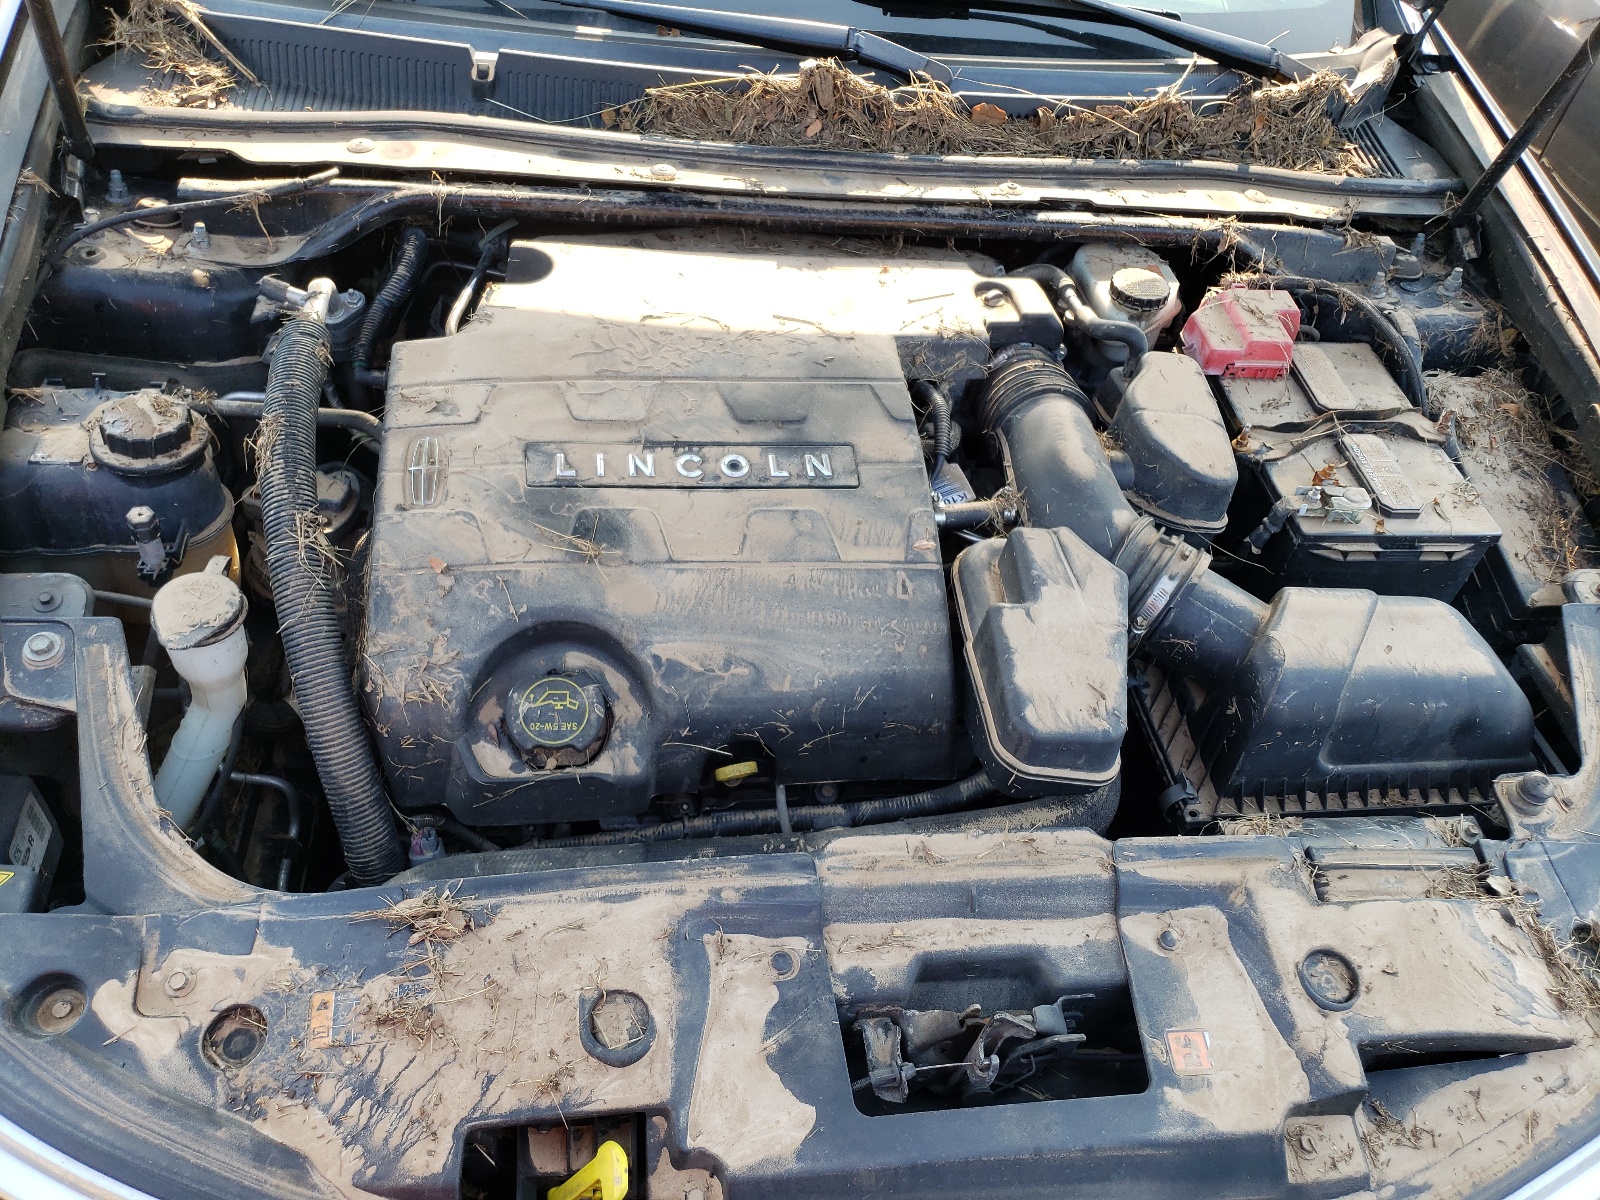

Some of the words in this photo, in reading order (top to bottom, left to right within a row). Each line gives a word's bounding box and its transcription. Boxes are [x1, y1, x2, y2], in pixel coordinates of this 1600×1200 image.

[556, 453, 833, 478] LINCOLN
[530, 722, 559, 731] 5W-20
[561, 722, 578, 731] SAE
